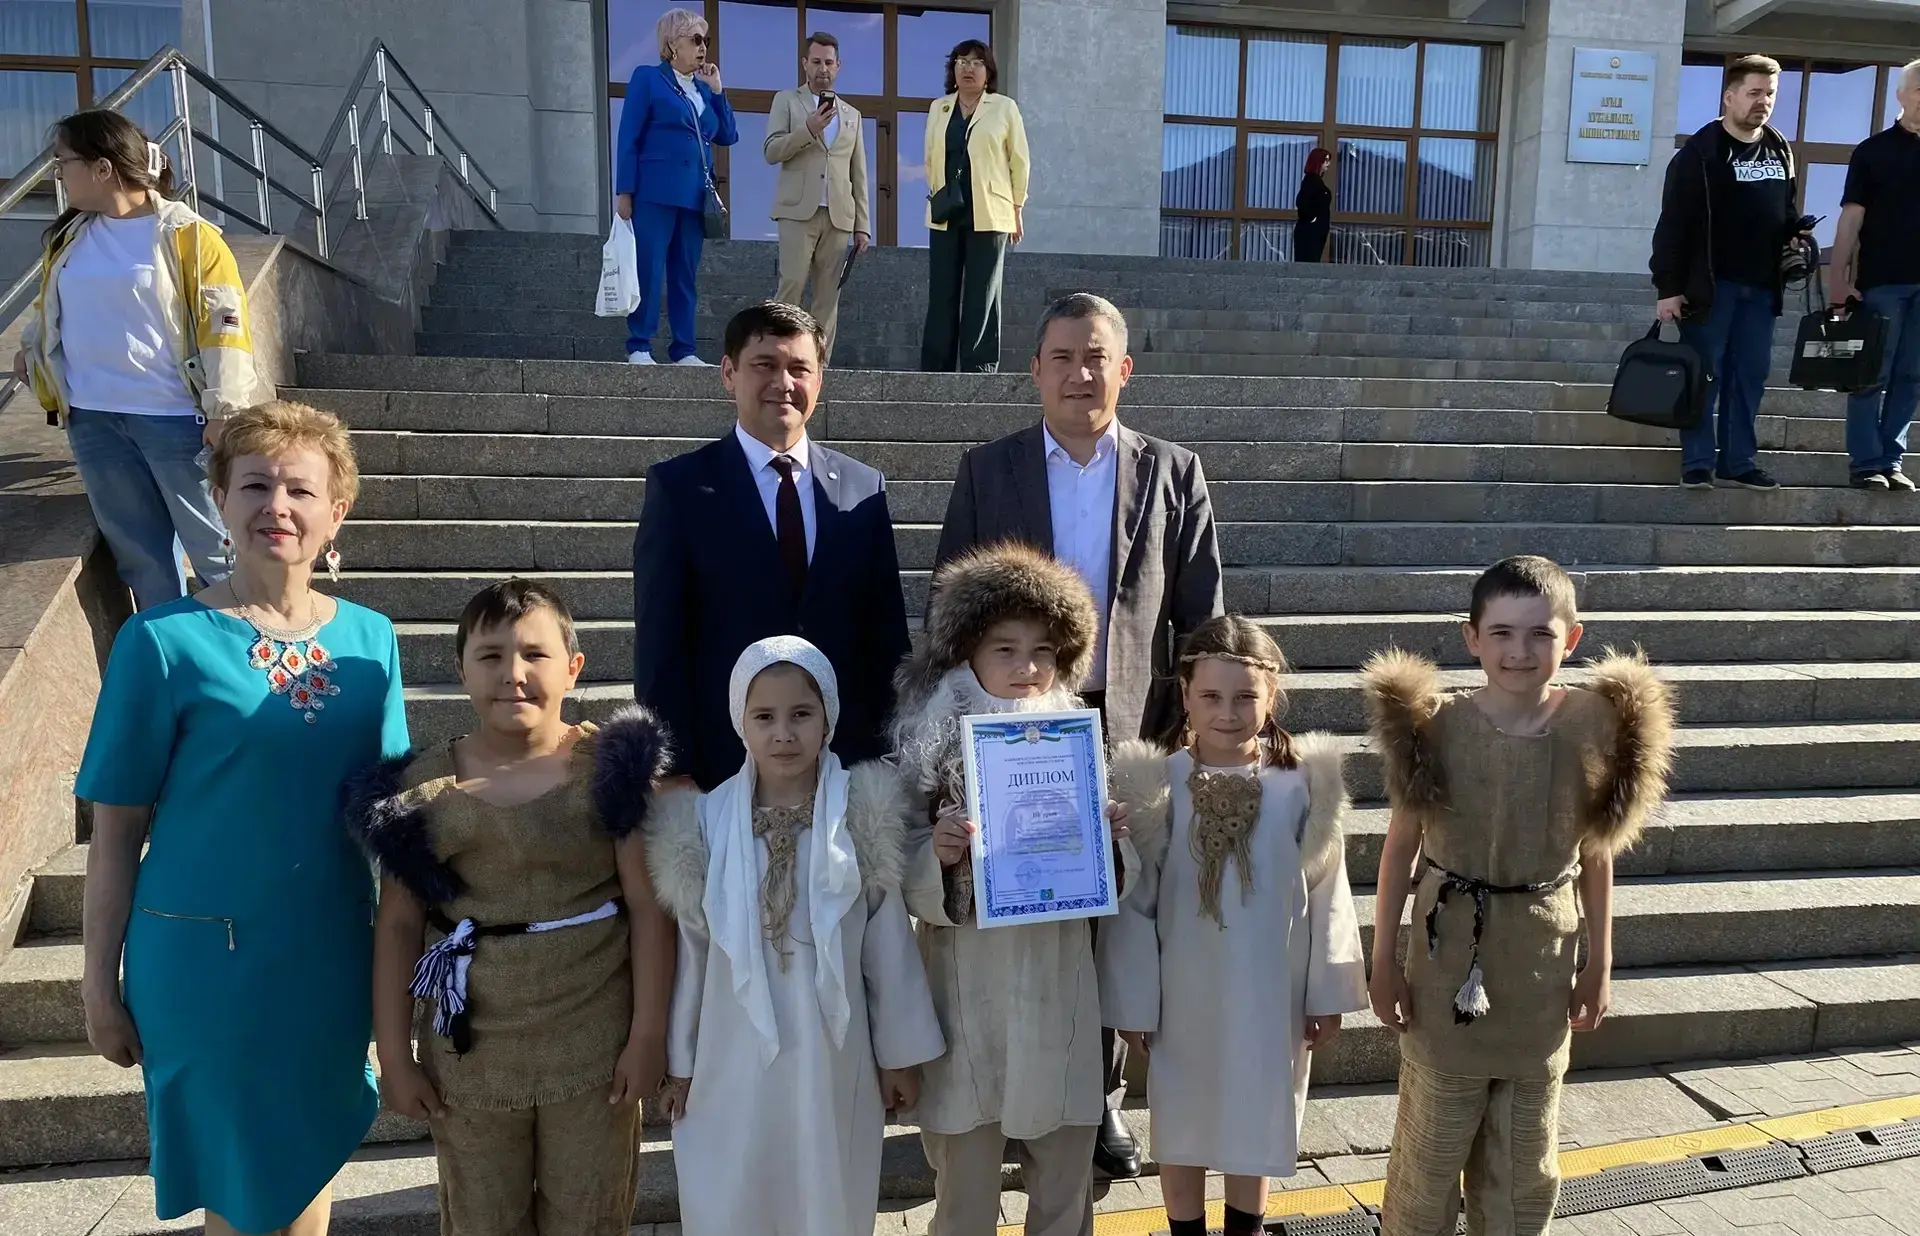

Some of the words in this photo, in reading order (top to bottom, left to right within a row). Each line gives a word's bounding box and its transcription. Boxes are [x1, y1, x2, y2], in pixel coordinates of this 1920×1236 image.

[1732, 157, 1783, 169] depeche
[1737, 167, 1784, 179] MODE
[1007, 770, 1075, 788] ДИПЛОМ
